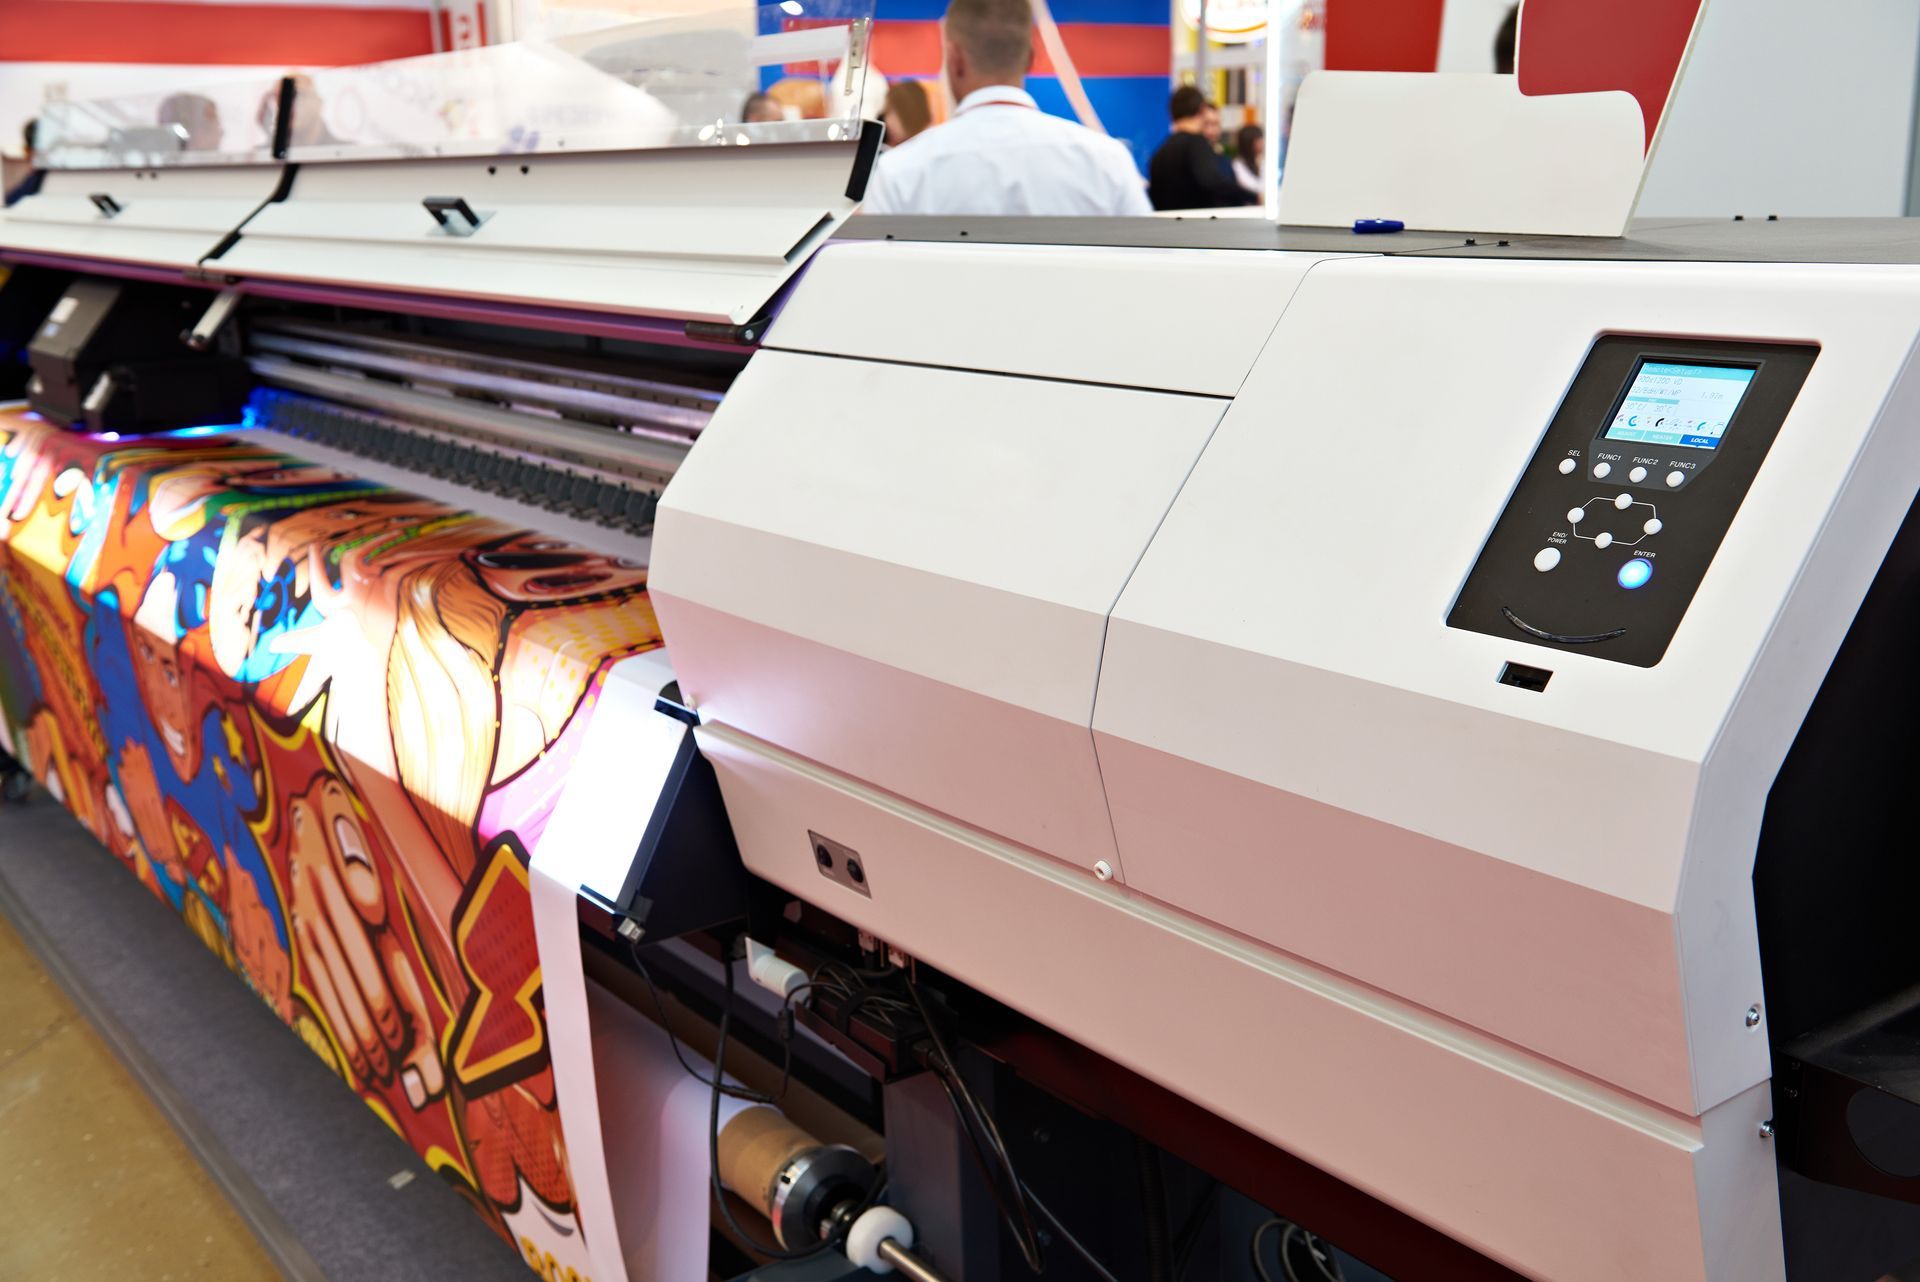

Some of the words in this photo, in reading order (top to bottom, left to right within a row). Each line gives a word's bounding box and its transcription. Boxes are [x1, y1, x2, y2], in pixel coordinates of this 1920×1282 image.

[1690, 437, 1709, 445] LOCAL
[1567, 449, 1581, 457] SEL
[1597, 452, 1622, 461] FUNC1
[1632, 456, 1659, 466] FUNC2
[1669, 460, 1697, 470] FUNC3
[1547, 537, 1568, 545] POWER
[1633, 550, 1657, 558] ENTER
